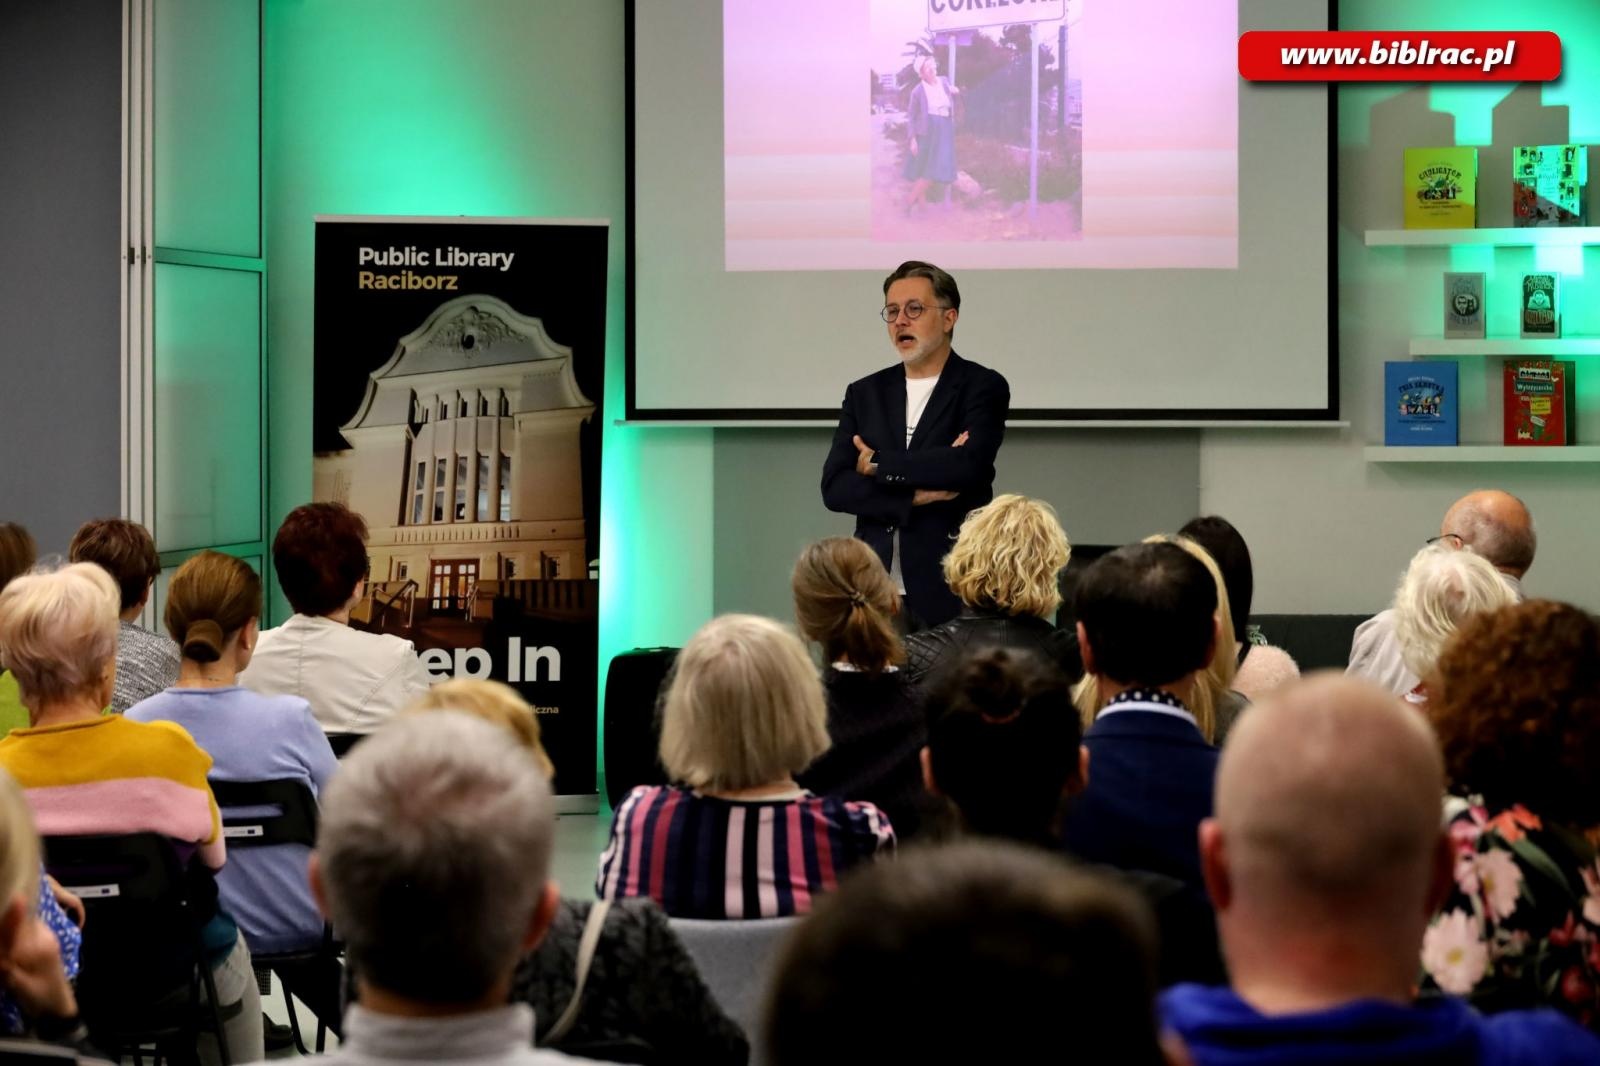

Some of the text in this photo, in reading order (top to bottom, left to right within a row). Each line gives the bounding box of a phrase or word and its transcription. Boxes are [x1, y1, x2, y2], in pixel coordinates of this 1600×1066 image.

[360, 246, 514, 271] Public Library
[359, 270, 458, 289] Raciborz
[415, 636, 561, 682] ep In
[528, 704, 559, 714] liczna
